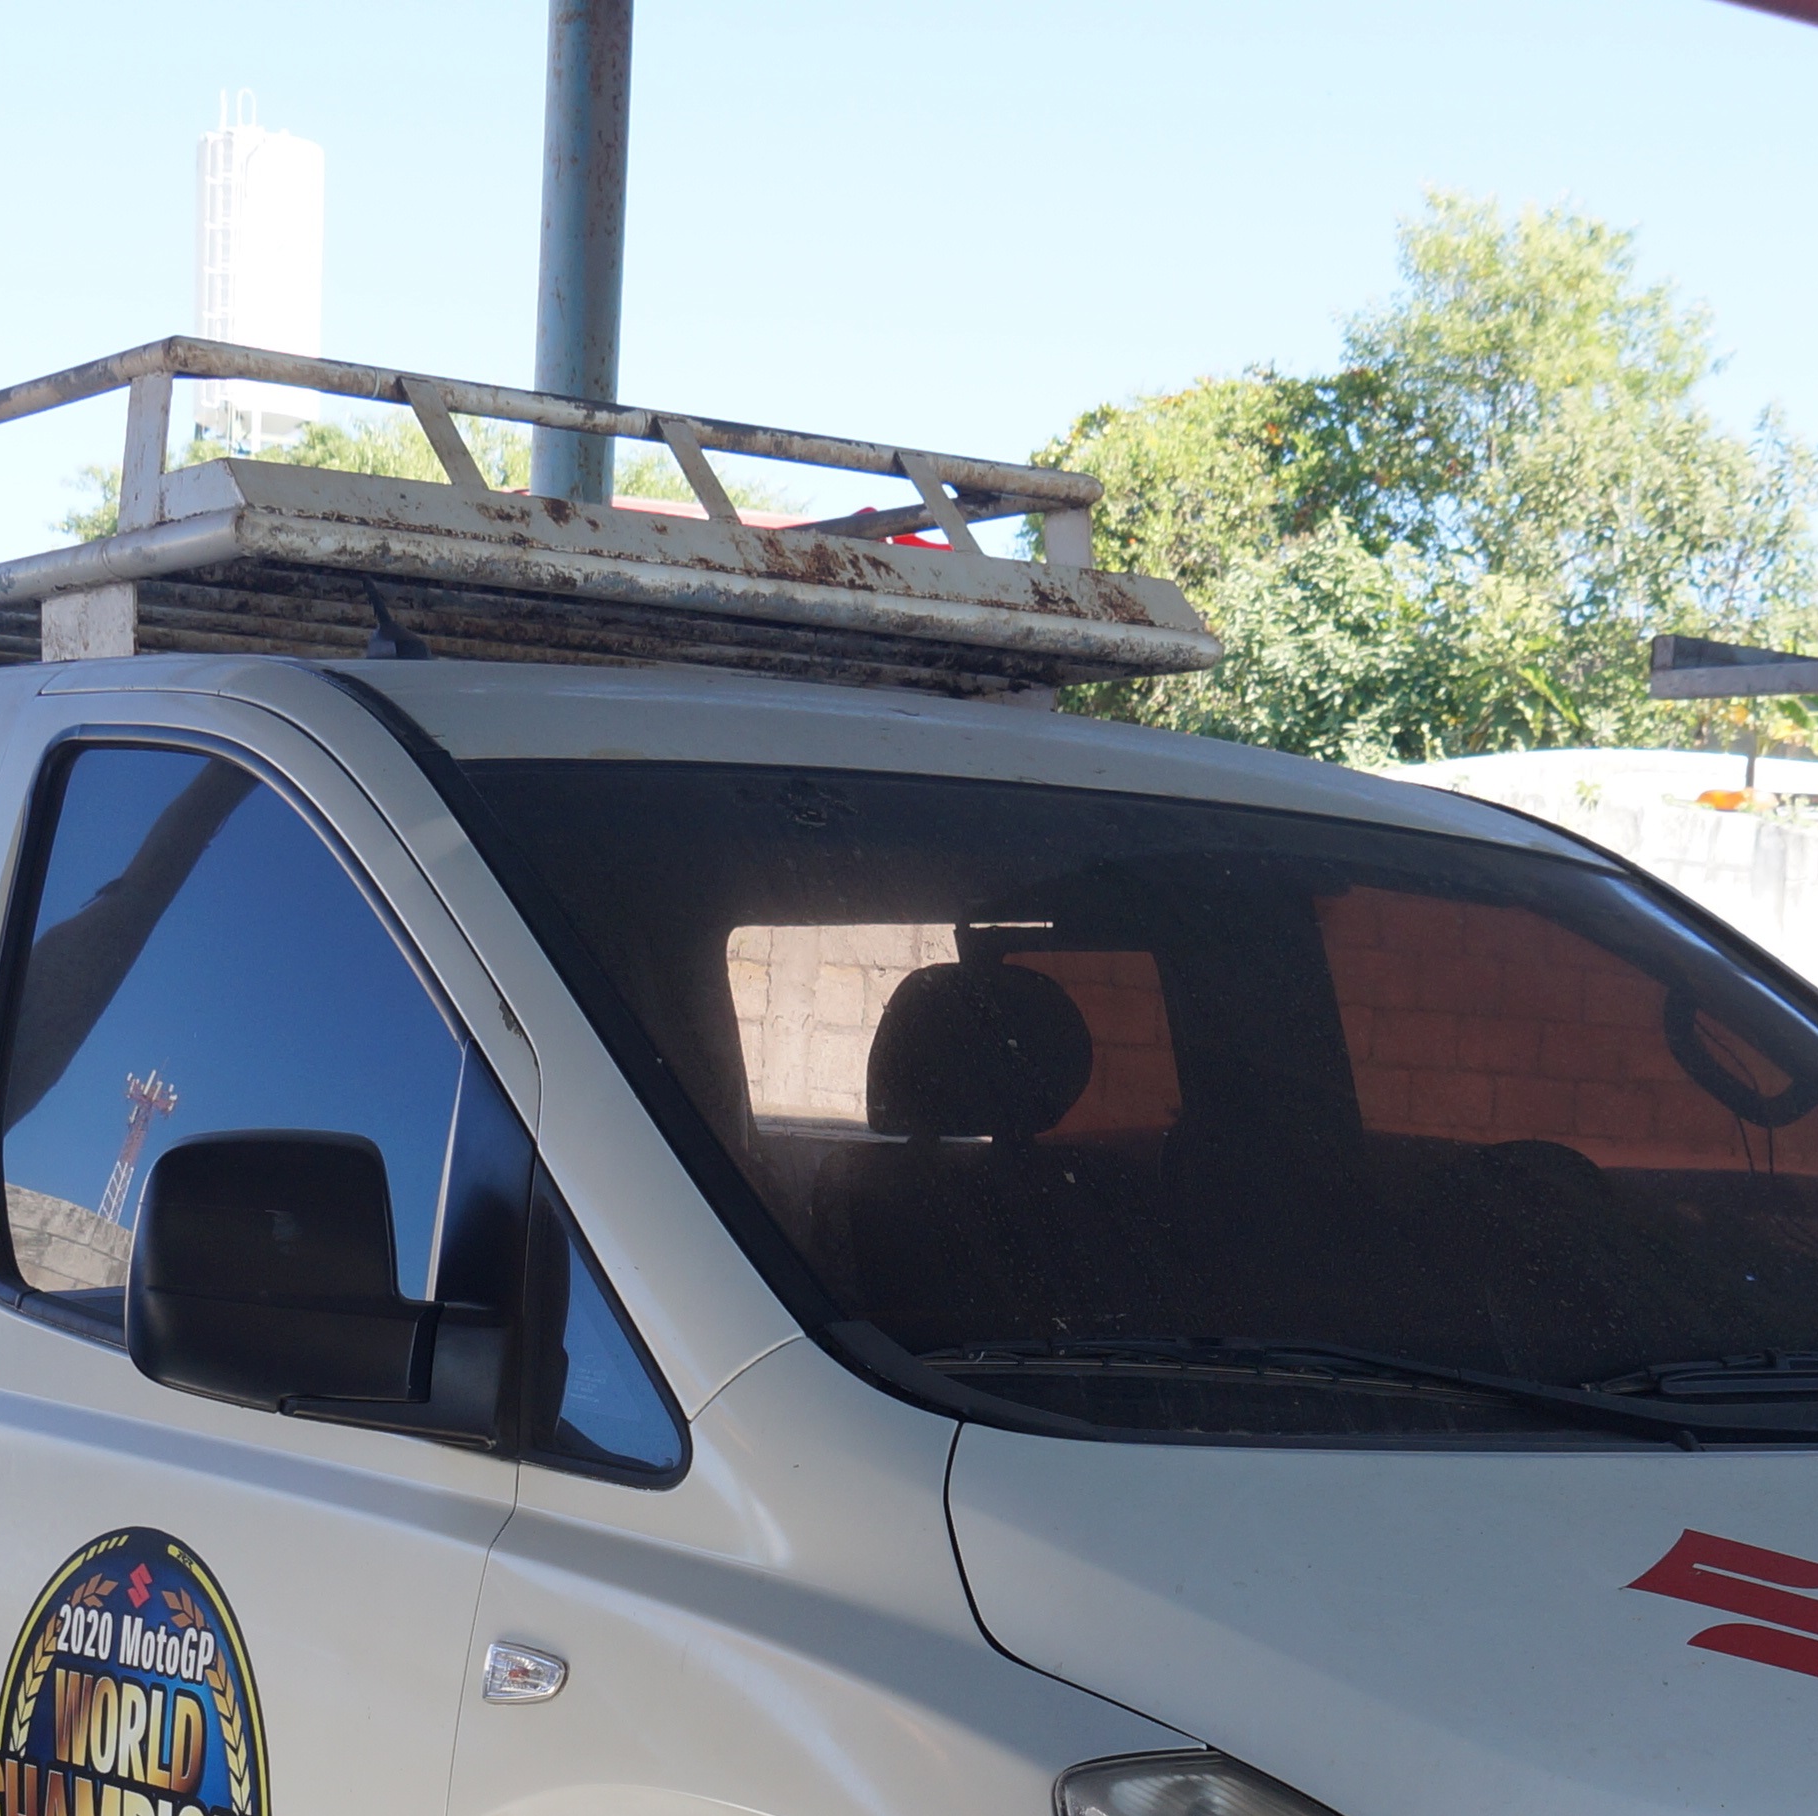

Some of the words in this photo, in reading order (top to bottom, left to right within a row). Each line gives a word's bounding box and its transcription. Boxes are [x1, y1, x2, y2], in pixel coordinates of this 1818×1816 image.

[57, 1603, 113, 1660] 2020
[118, 1614, 215, 1682] MotoGP
[55, 1667, 204, 1794] WORLD
